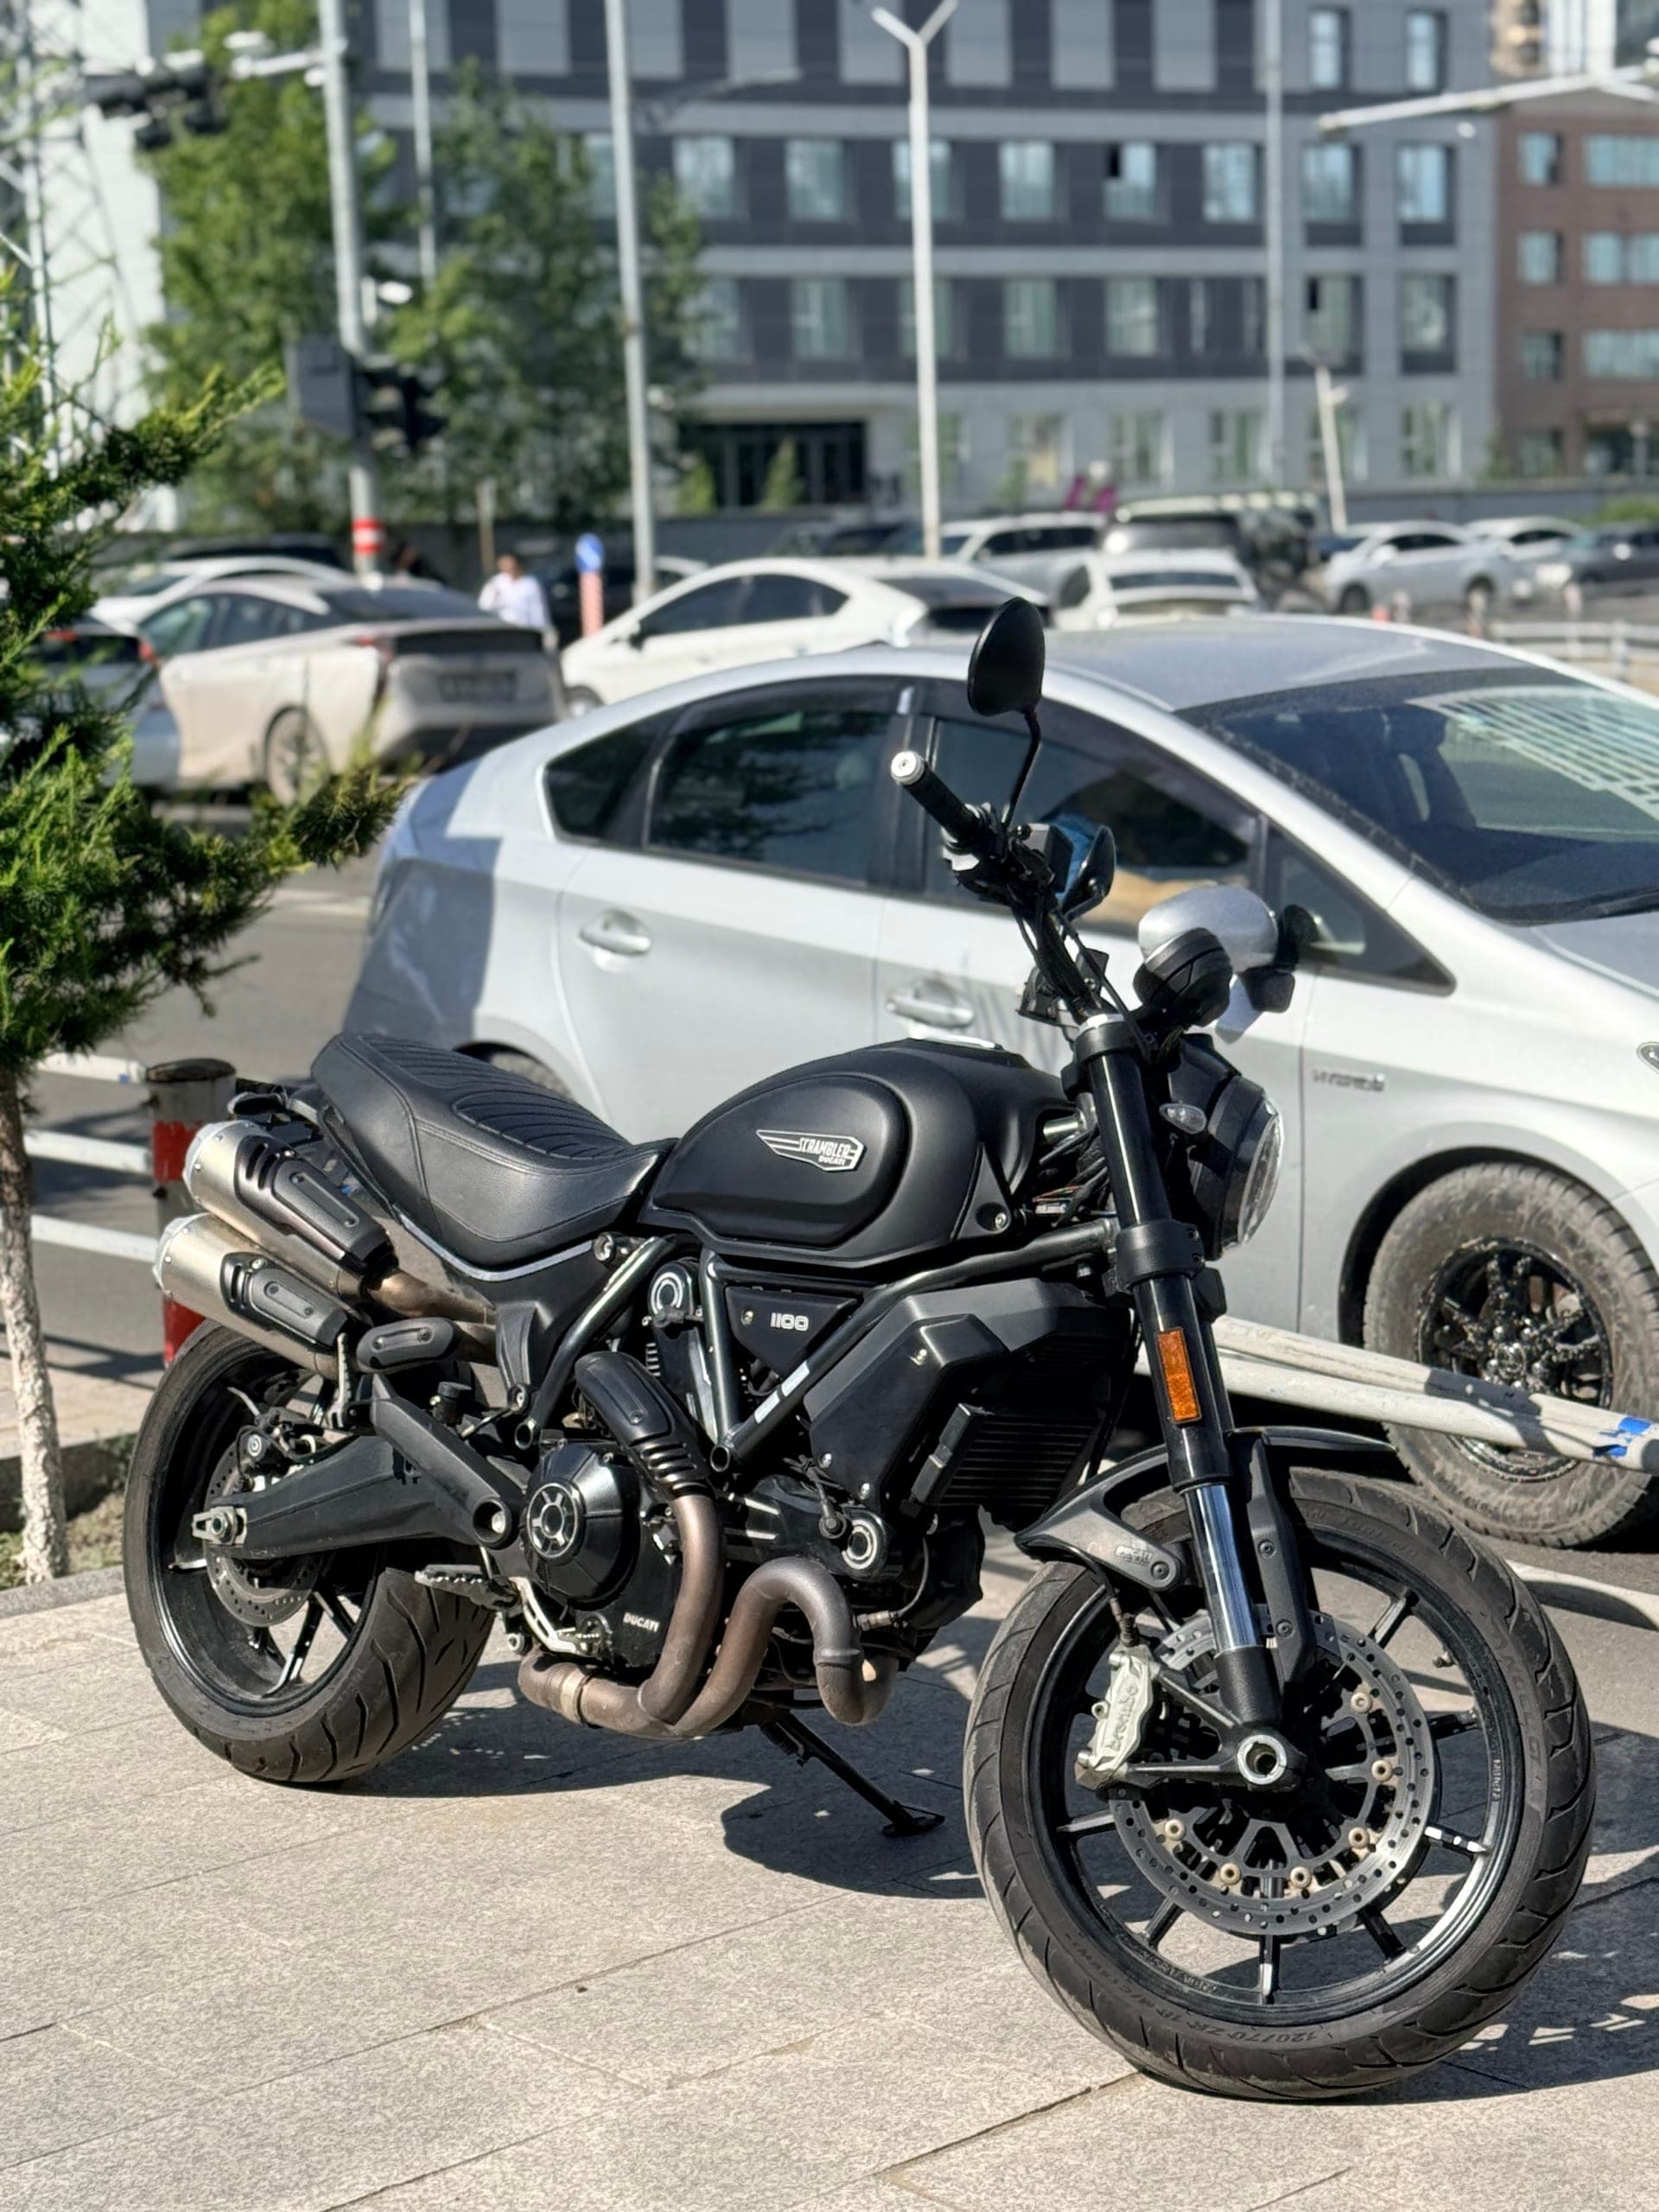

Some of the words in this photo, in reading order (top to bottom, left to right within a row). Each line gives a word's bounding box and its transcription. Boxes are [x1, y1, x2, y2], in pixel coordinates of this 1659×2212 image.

[798, 1137, 851, 1158] SCRAMBLER
[818, 1154, 846, 1166] DUCATI
[770, 1312, 810, 1332] 1100
[623, 1611, 660, 1633] DUCATI
[1104, 1682, 1139, 1751] brembo
[1228, 2031, 1319, 2044] 120/70
